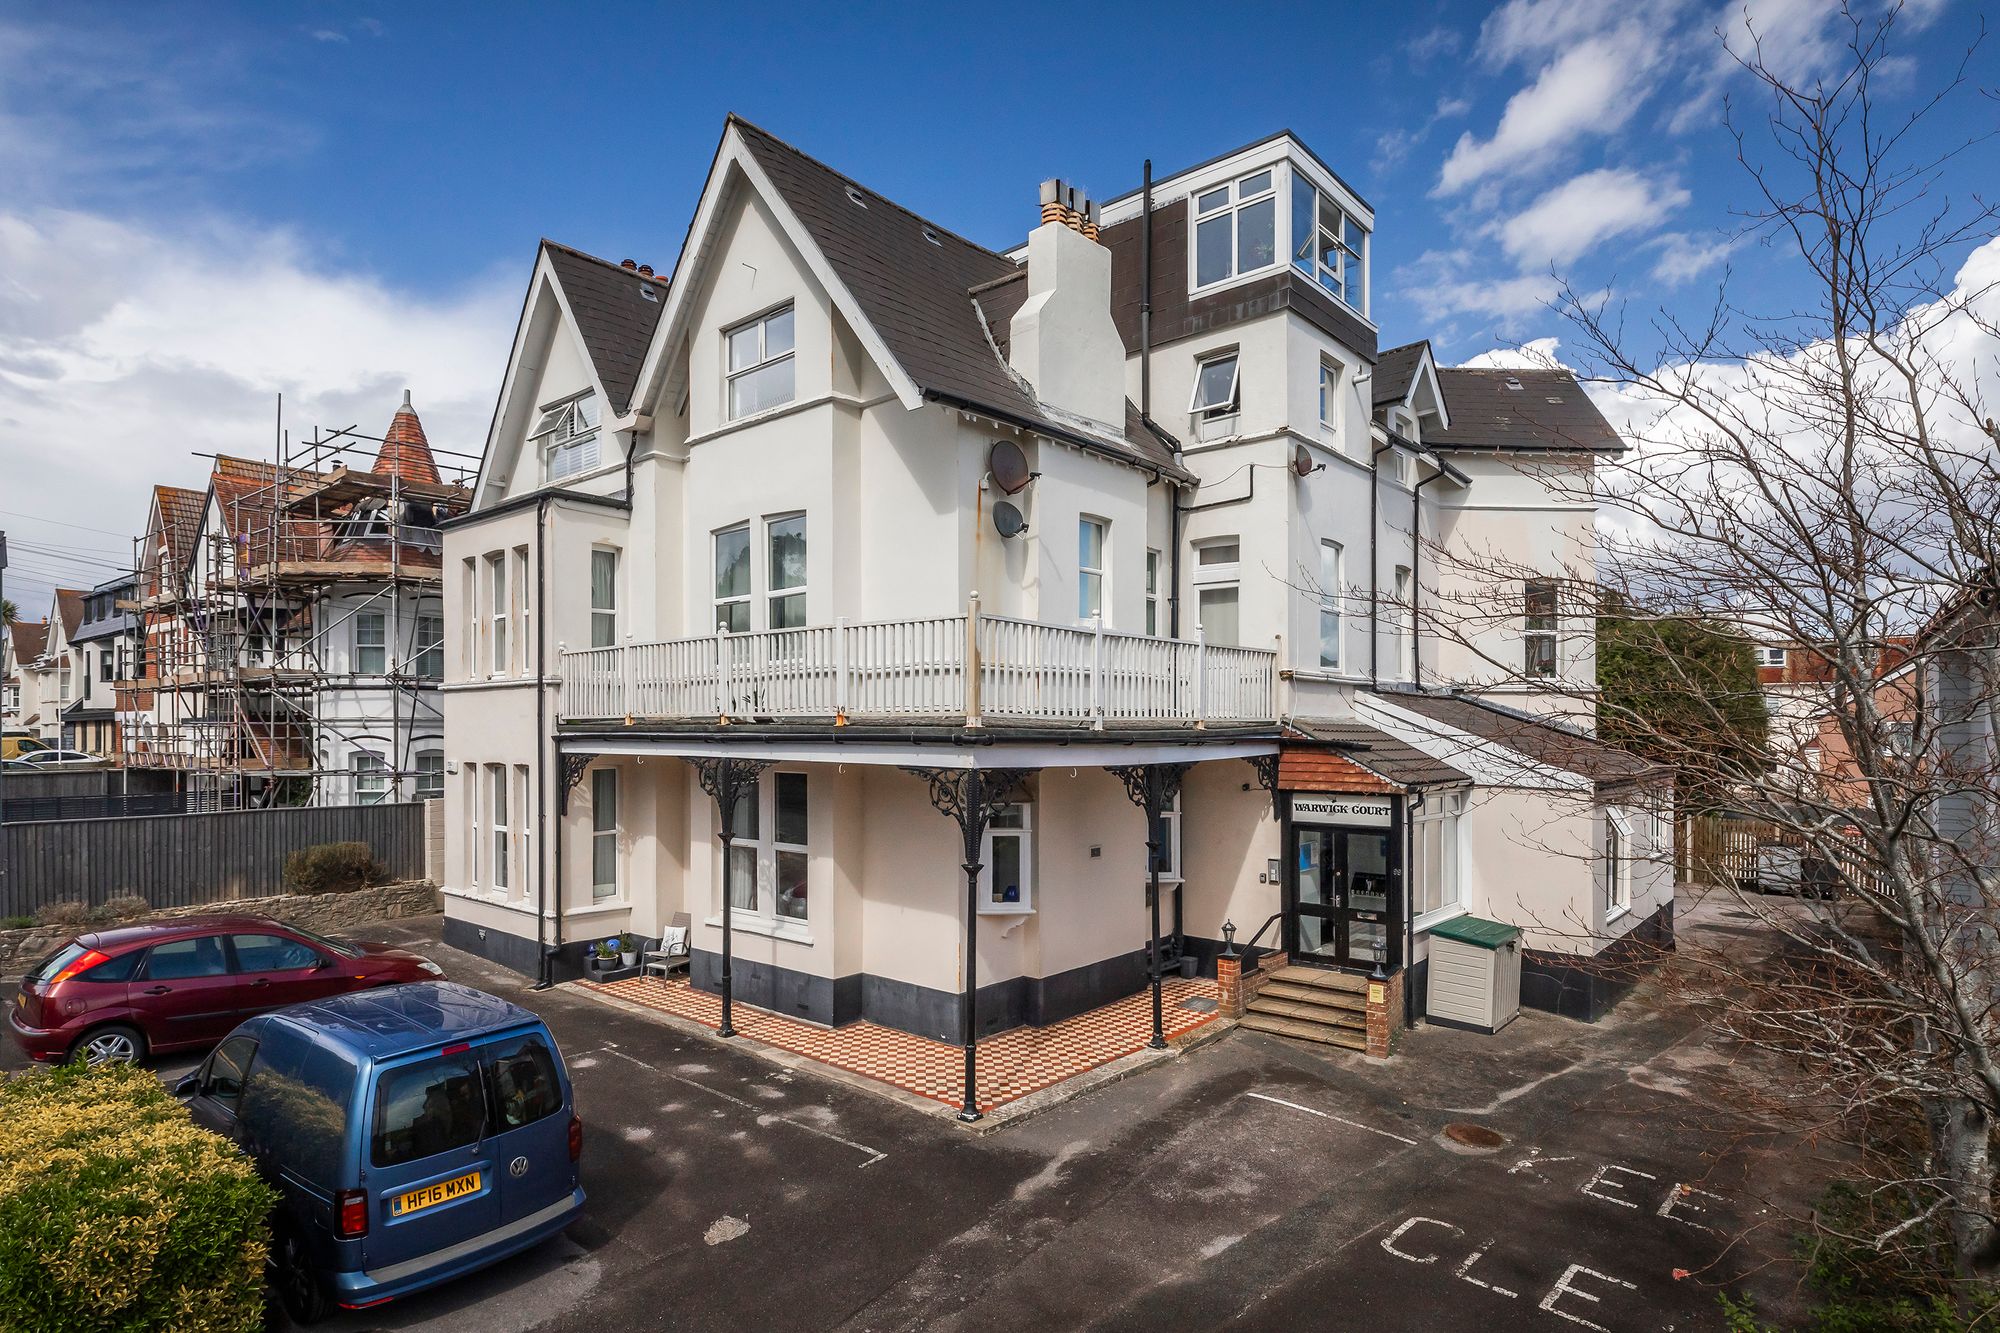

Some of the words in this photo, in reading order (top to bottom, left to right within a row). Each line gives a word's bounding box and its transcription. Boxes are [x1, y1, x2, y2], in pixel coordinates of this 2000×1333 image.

[1294, 803, 1348, 814] WARWICK
[1351, 805, 1391, 816] COURT
[407, 1187, 443, 1209] HF16
[446, 1176, 475, 1197] MXN
